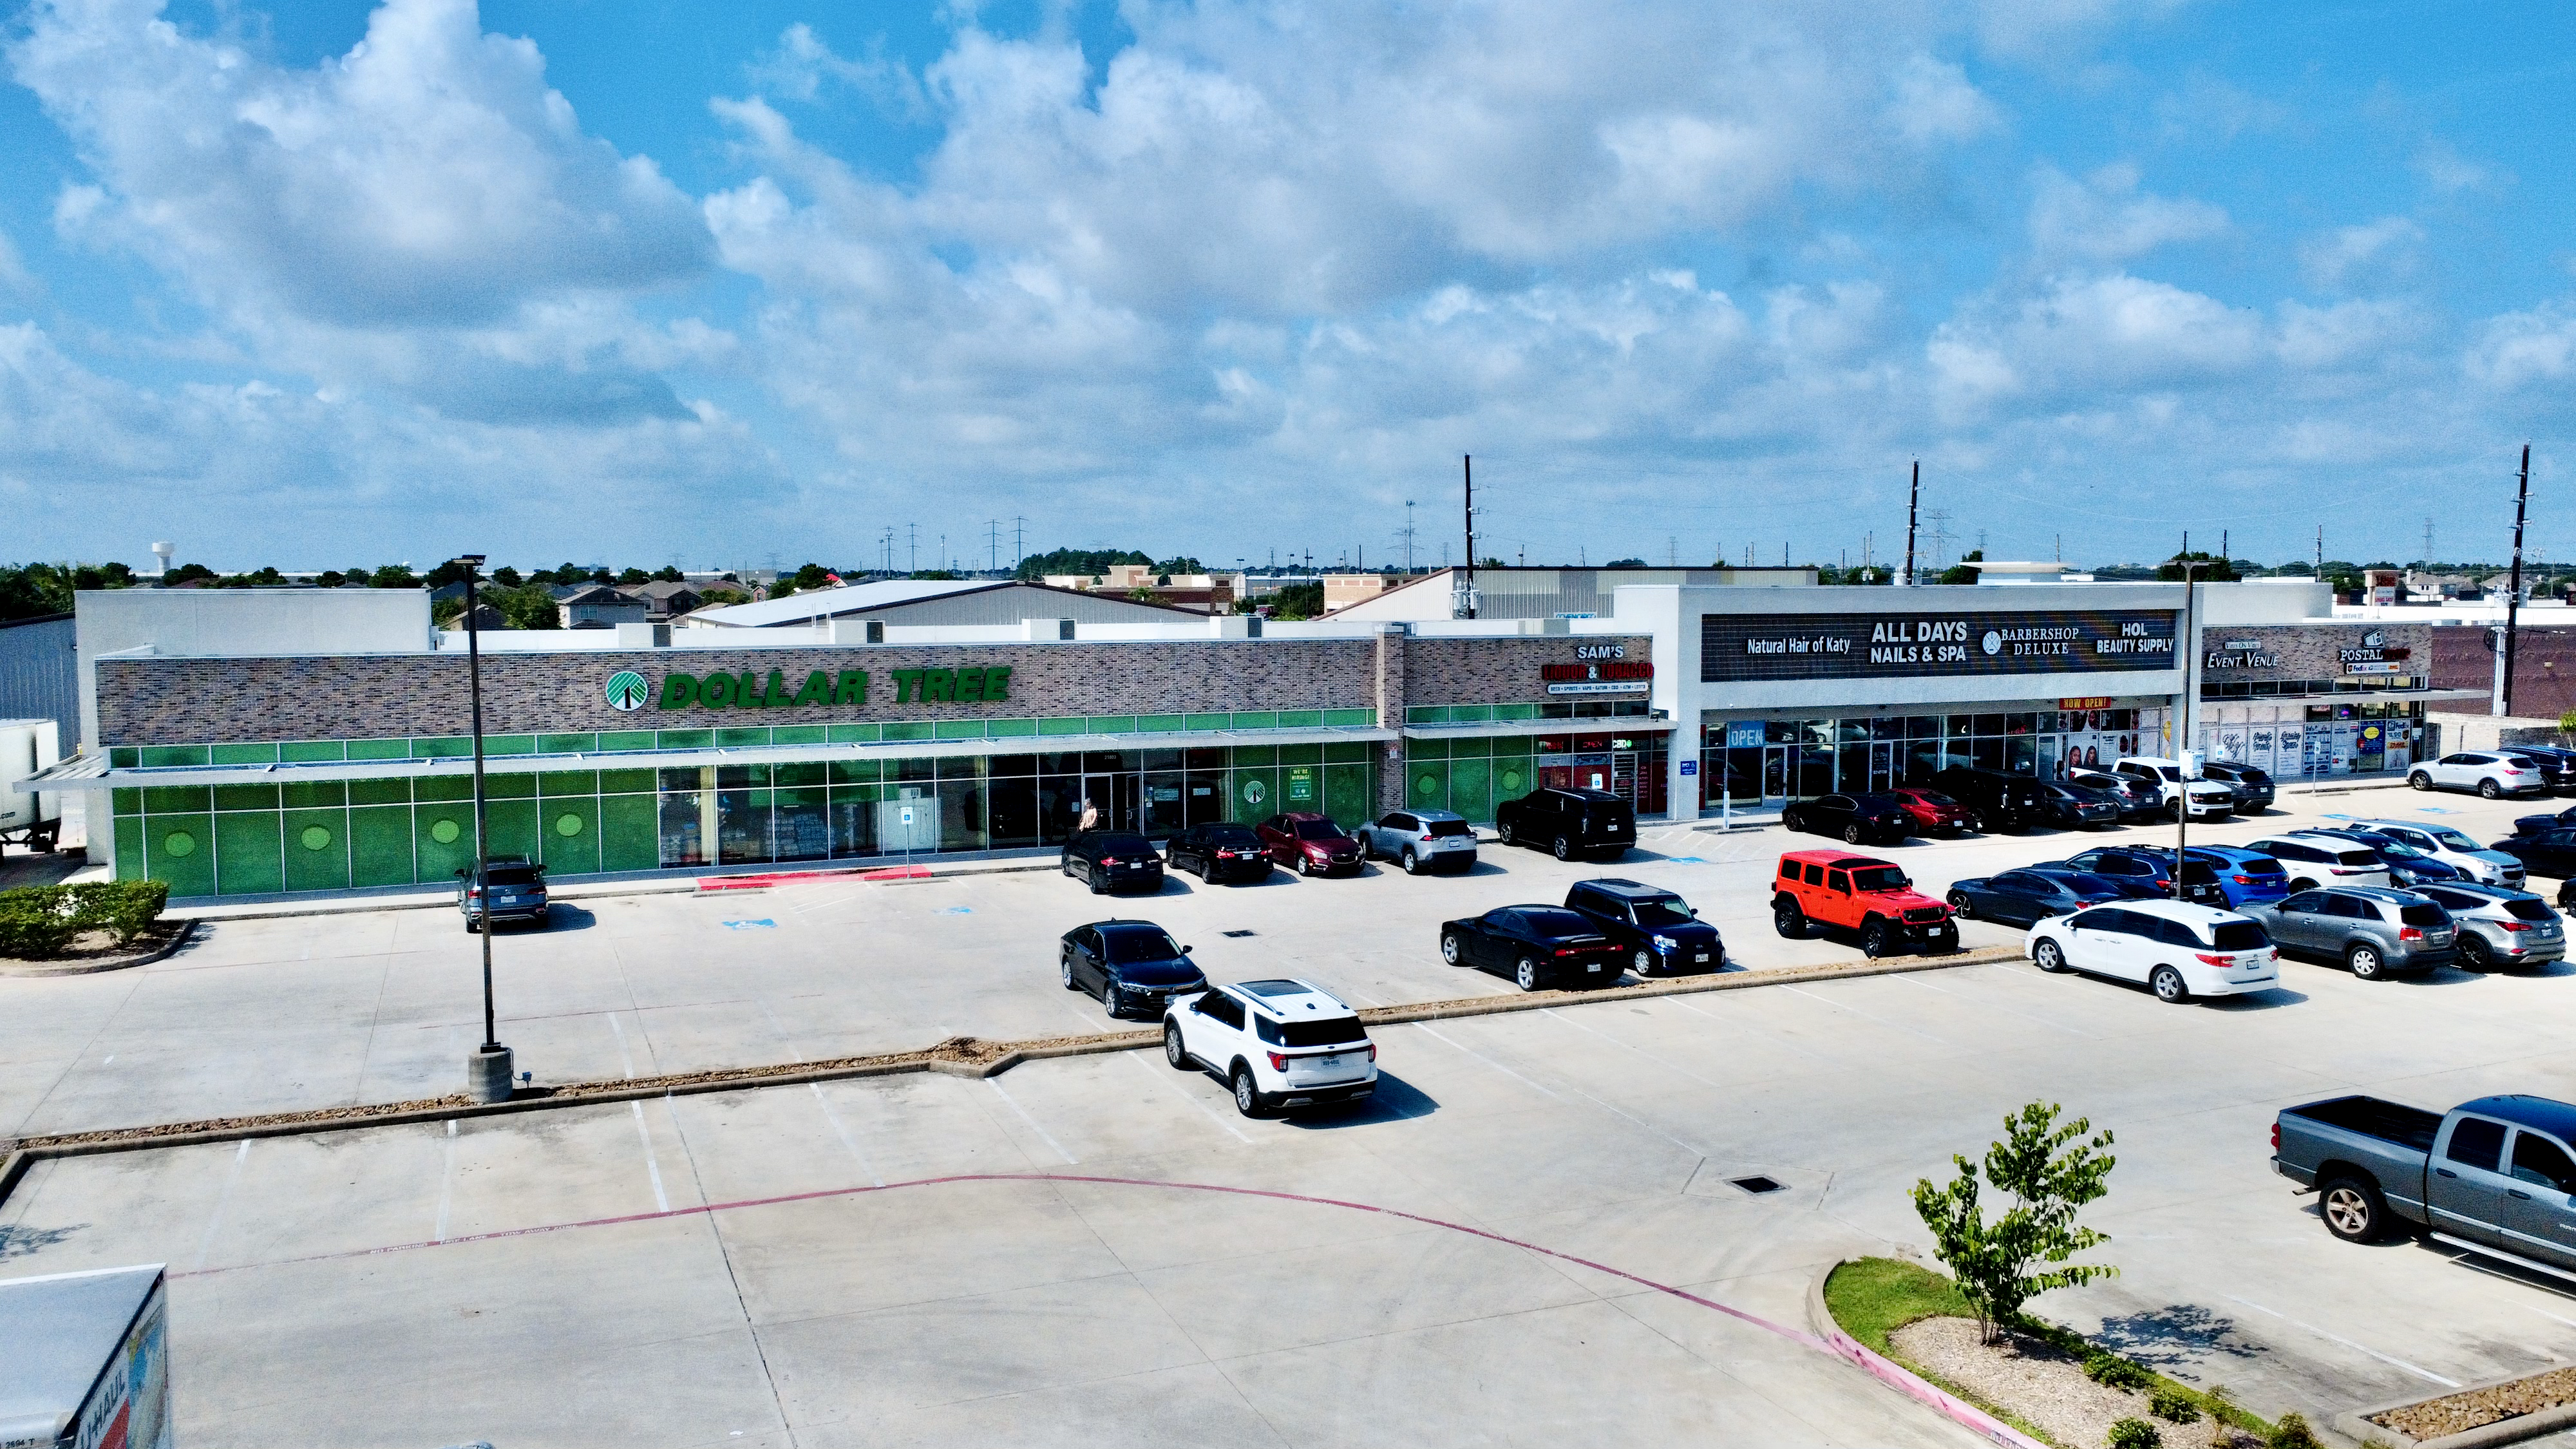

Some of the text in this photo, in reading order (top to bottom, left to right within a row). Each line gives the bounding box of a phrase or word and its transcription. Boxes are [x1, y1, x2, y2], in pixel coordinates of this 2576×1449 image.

[1871, 621, 1967, 642] ALL DAYS
[2001, 627, 2079, 641] BARBERSHOP
[2121, 622, 2148, 636] HOL
[1747, 636, 1850, 654] Natural Hair of Katy
[2014, 642, 2069, 655] DELUXE
[2097, 638, 2174, 653] BEAUTY SUPPLY
[1578, 646, 1624, 659] SAM'S
[1871, 646, 1966, 663] NAILS & SPA
[2340, 649, 2383, 661] POSTAL
[1543, 662, 1654, 680] LIQUOR & TOBACCO
[659, 667, 1012, 708] DOLLAR TREE
[2064, 697, 2107, 708] NOW OPEN!
[1612, 740, 1627, 749] CBD
[1731, 729, 1763, 746] OPEN
